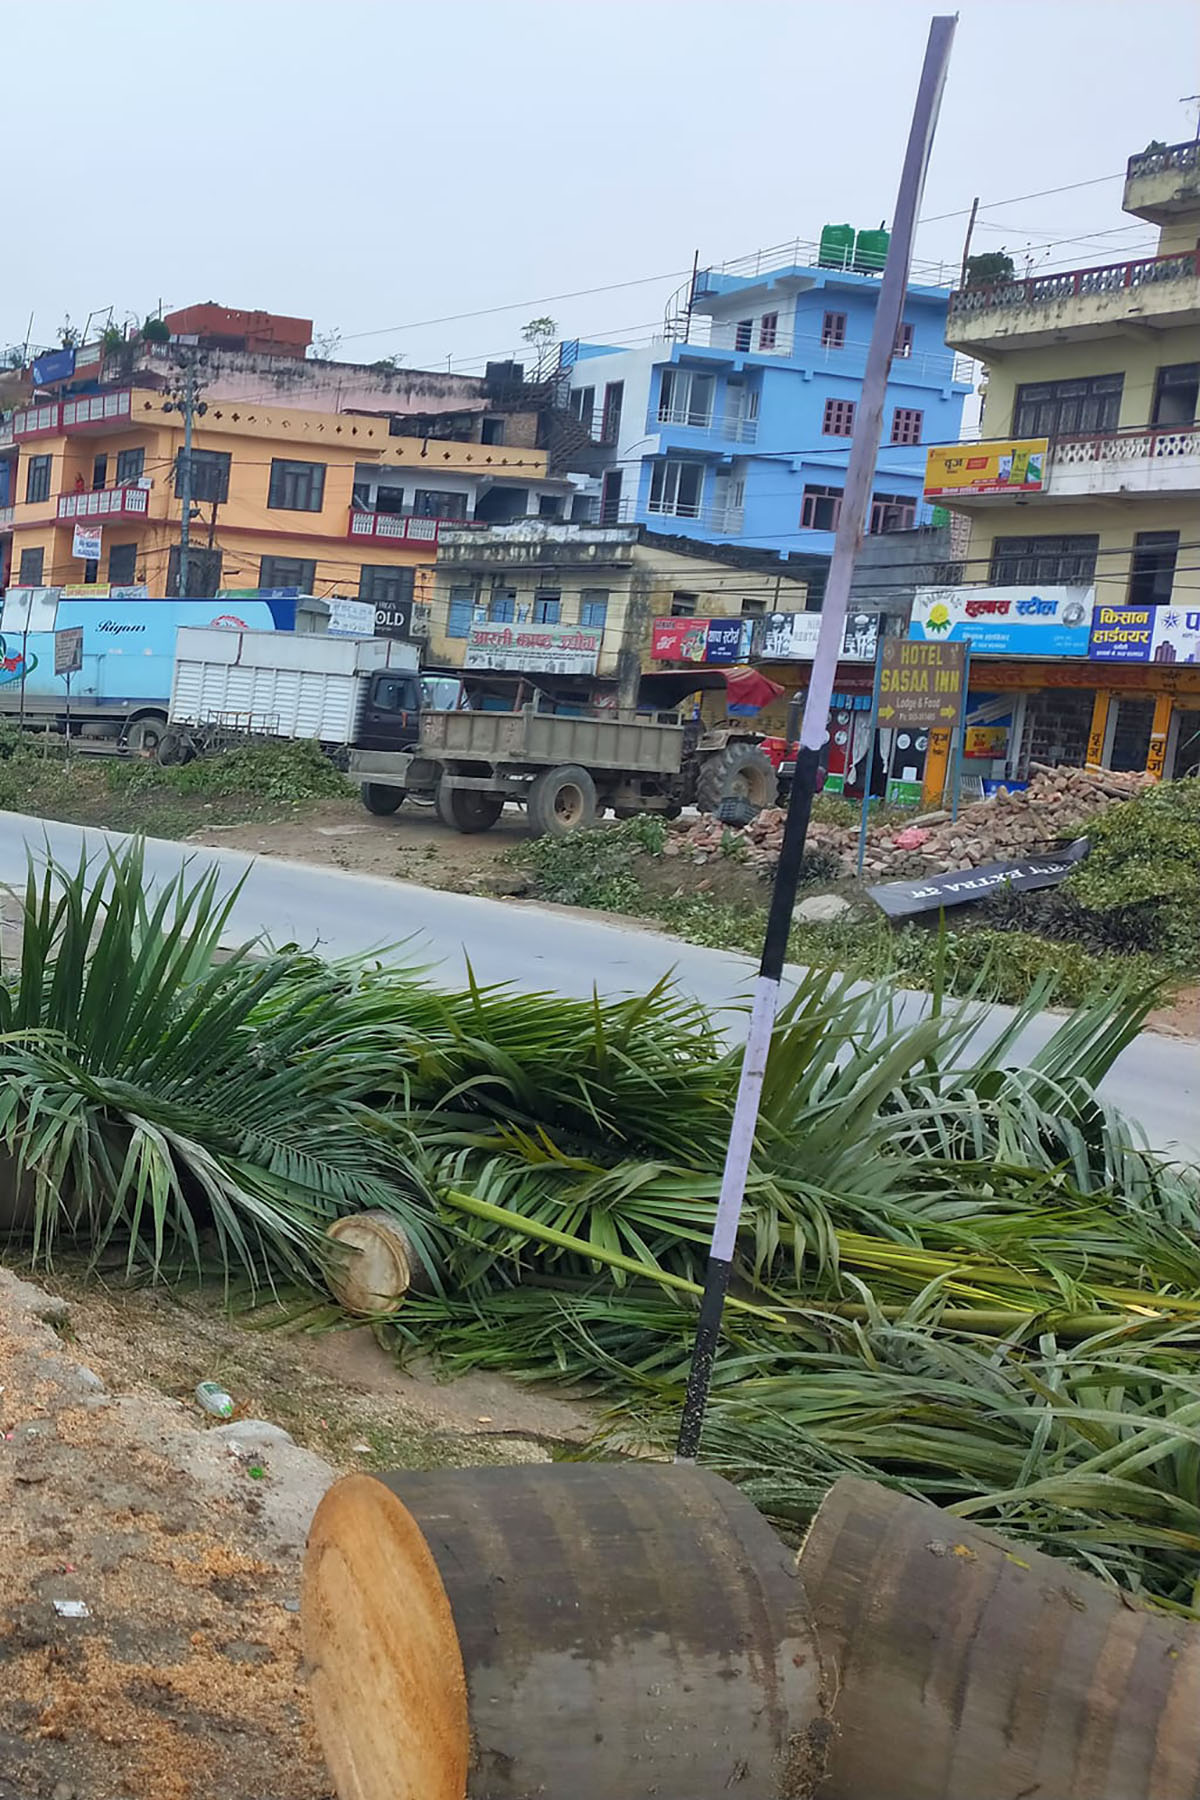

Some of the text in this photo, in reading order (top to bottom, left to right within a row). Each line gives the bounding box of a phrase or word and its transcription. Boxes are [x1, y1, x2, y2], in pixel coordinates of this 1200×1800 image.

[1015, 595, 1059, 616] स्टील
[1100, 608, 1149, 624] किसान
[375, 610, 405, 627] OLD
[901, 644, 943, 666] HOTEL
[881, 669, 960, 693] SASAA INN
[896, 697, 916, 711] Lodge
[923, 697, 941, 708] Food
[944, 868, 1026, 893] EXTRA
